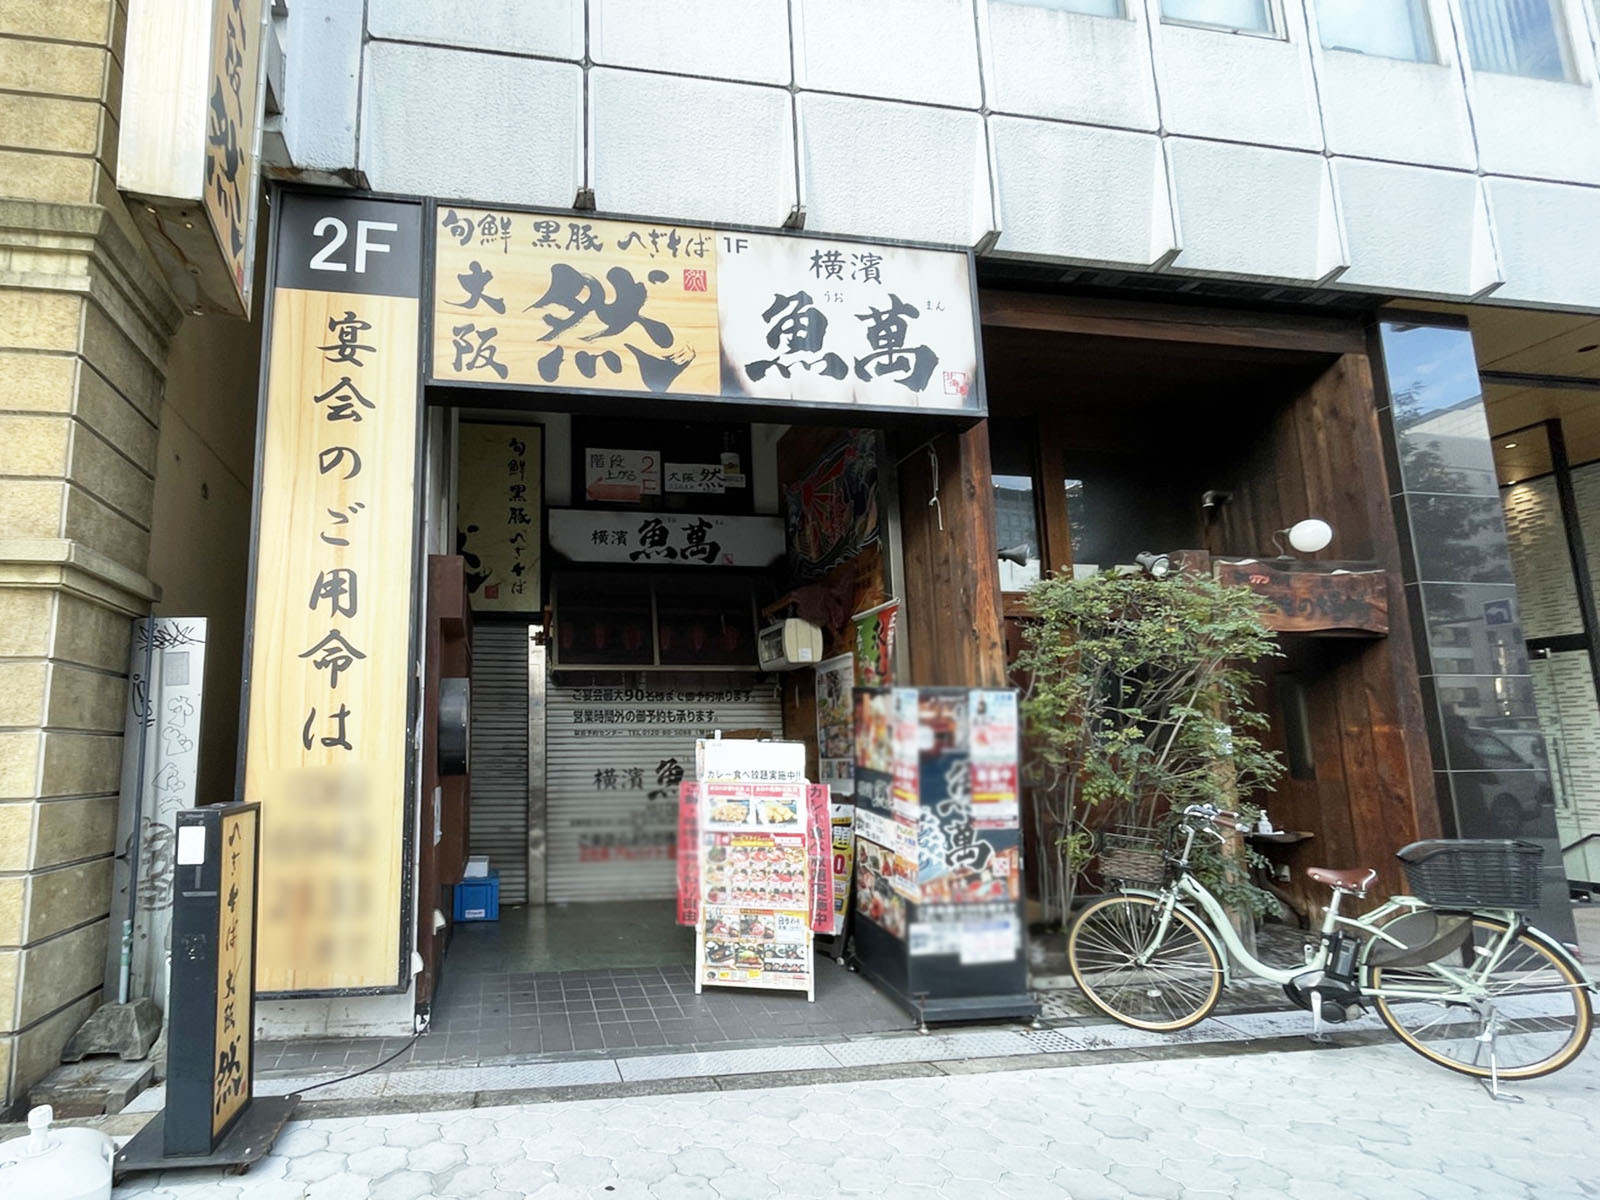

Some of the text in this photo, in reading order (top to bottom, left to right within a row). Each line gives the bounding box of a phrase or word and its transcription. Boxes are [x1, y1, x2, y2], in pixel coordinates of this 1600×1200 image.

[309, 216, 398, 273] 2F
[441, 209, 712, 259] 旬鮮 黒豚 へぎそば
[723, 236, 749, 254] 1F
[809, 249, 884, 285] 横濱
[442, 260, 697, 393] 大阪 然
[744, 289, 939, 393] 魚萬
[298, 311, 378, 751] 宴会のご用命は
[591, 529, 629, 546] 横濱
[592, 767, 646, 791] 横濱
